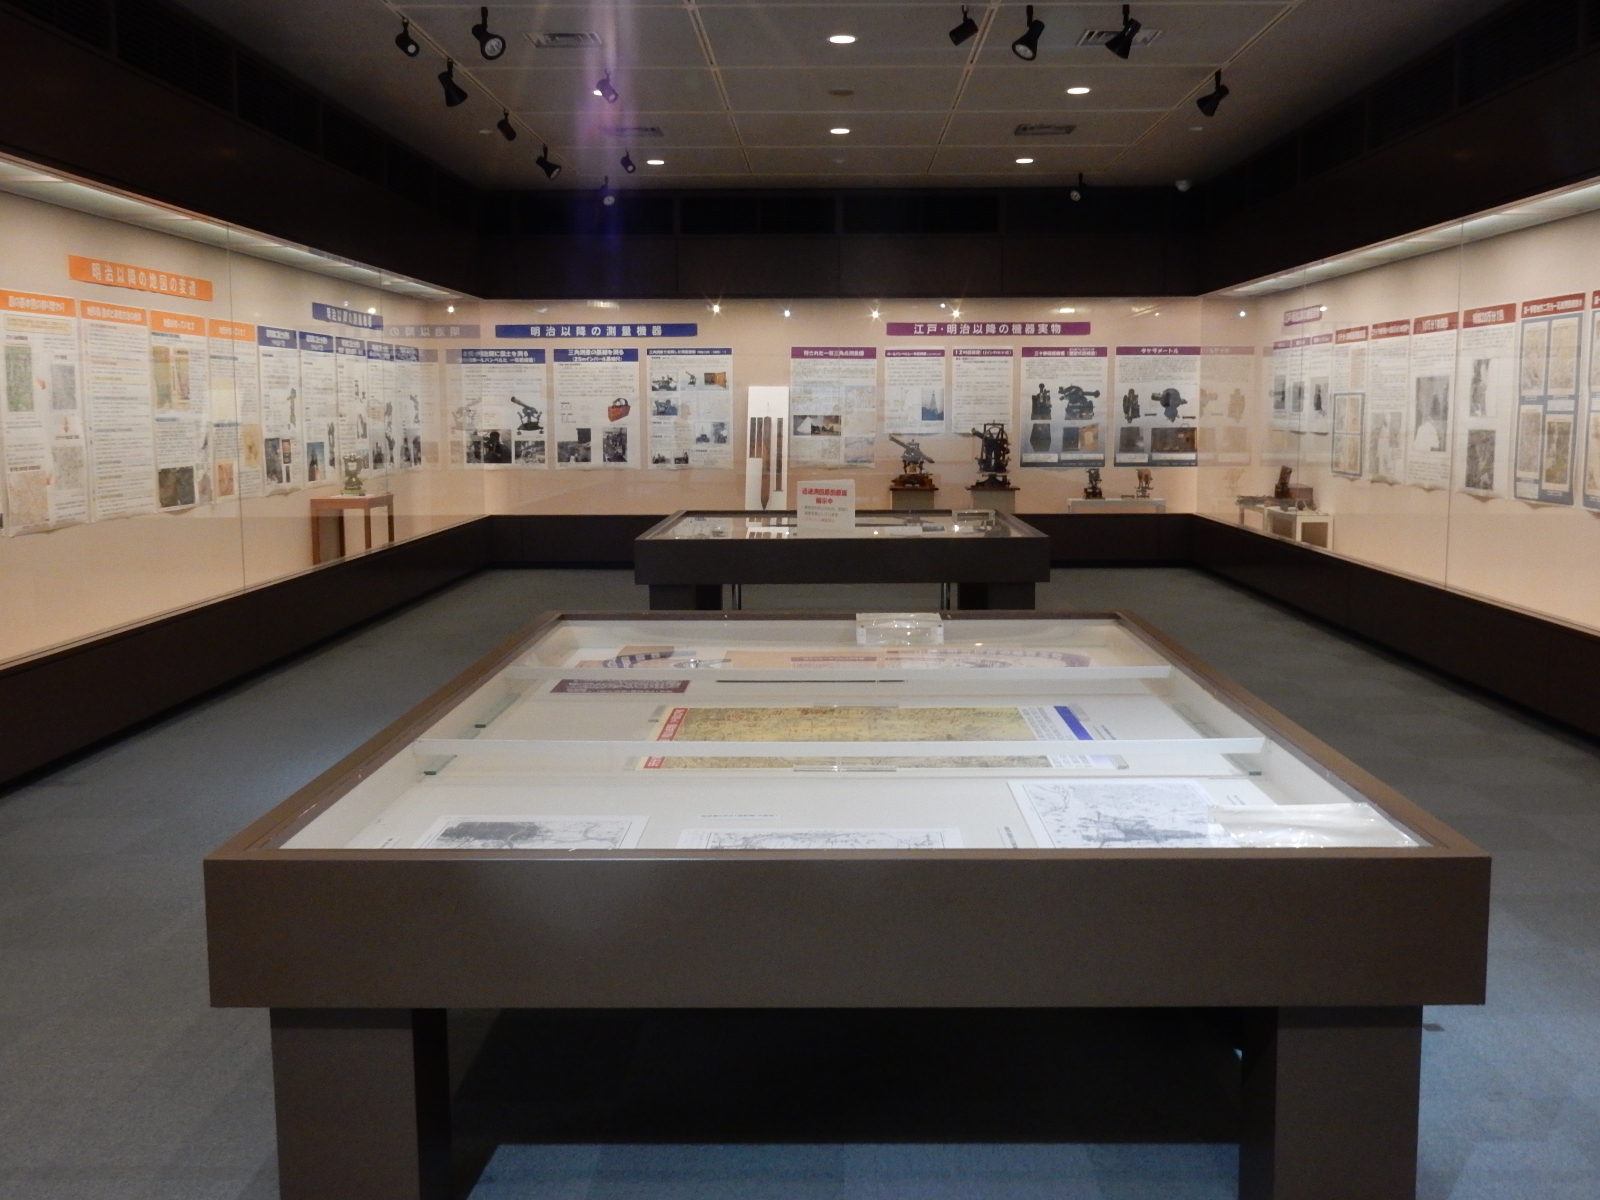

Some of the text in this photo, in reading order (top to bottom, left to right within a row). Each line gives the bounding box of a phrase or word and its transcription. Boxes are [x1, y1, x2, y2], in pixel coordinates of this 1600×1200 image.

[530, 325, 662, 337] 明治以降の測量機器
[913, 323, 1062, 335] 江戸・明治以降の機器実物
